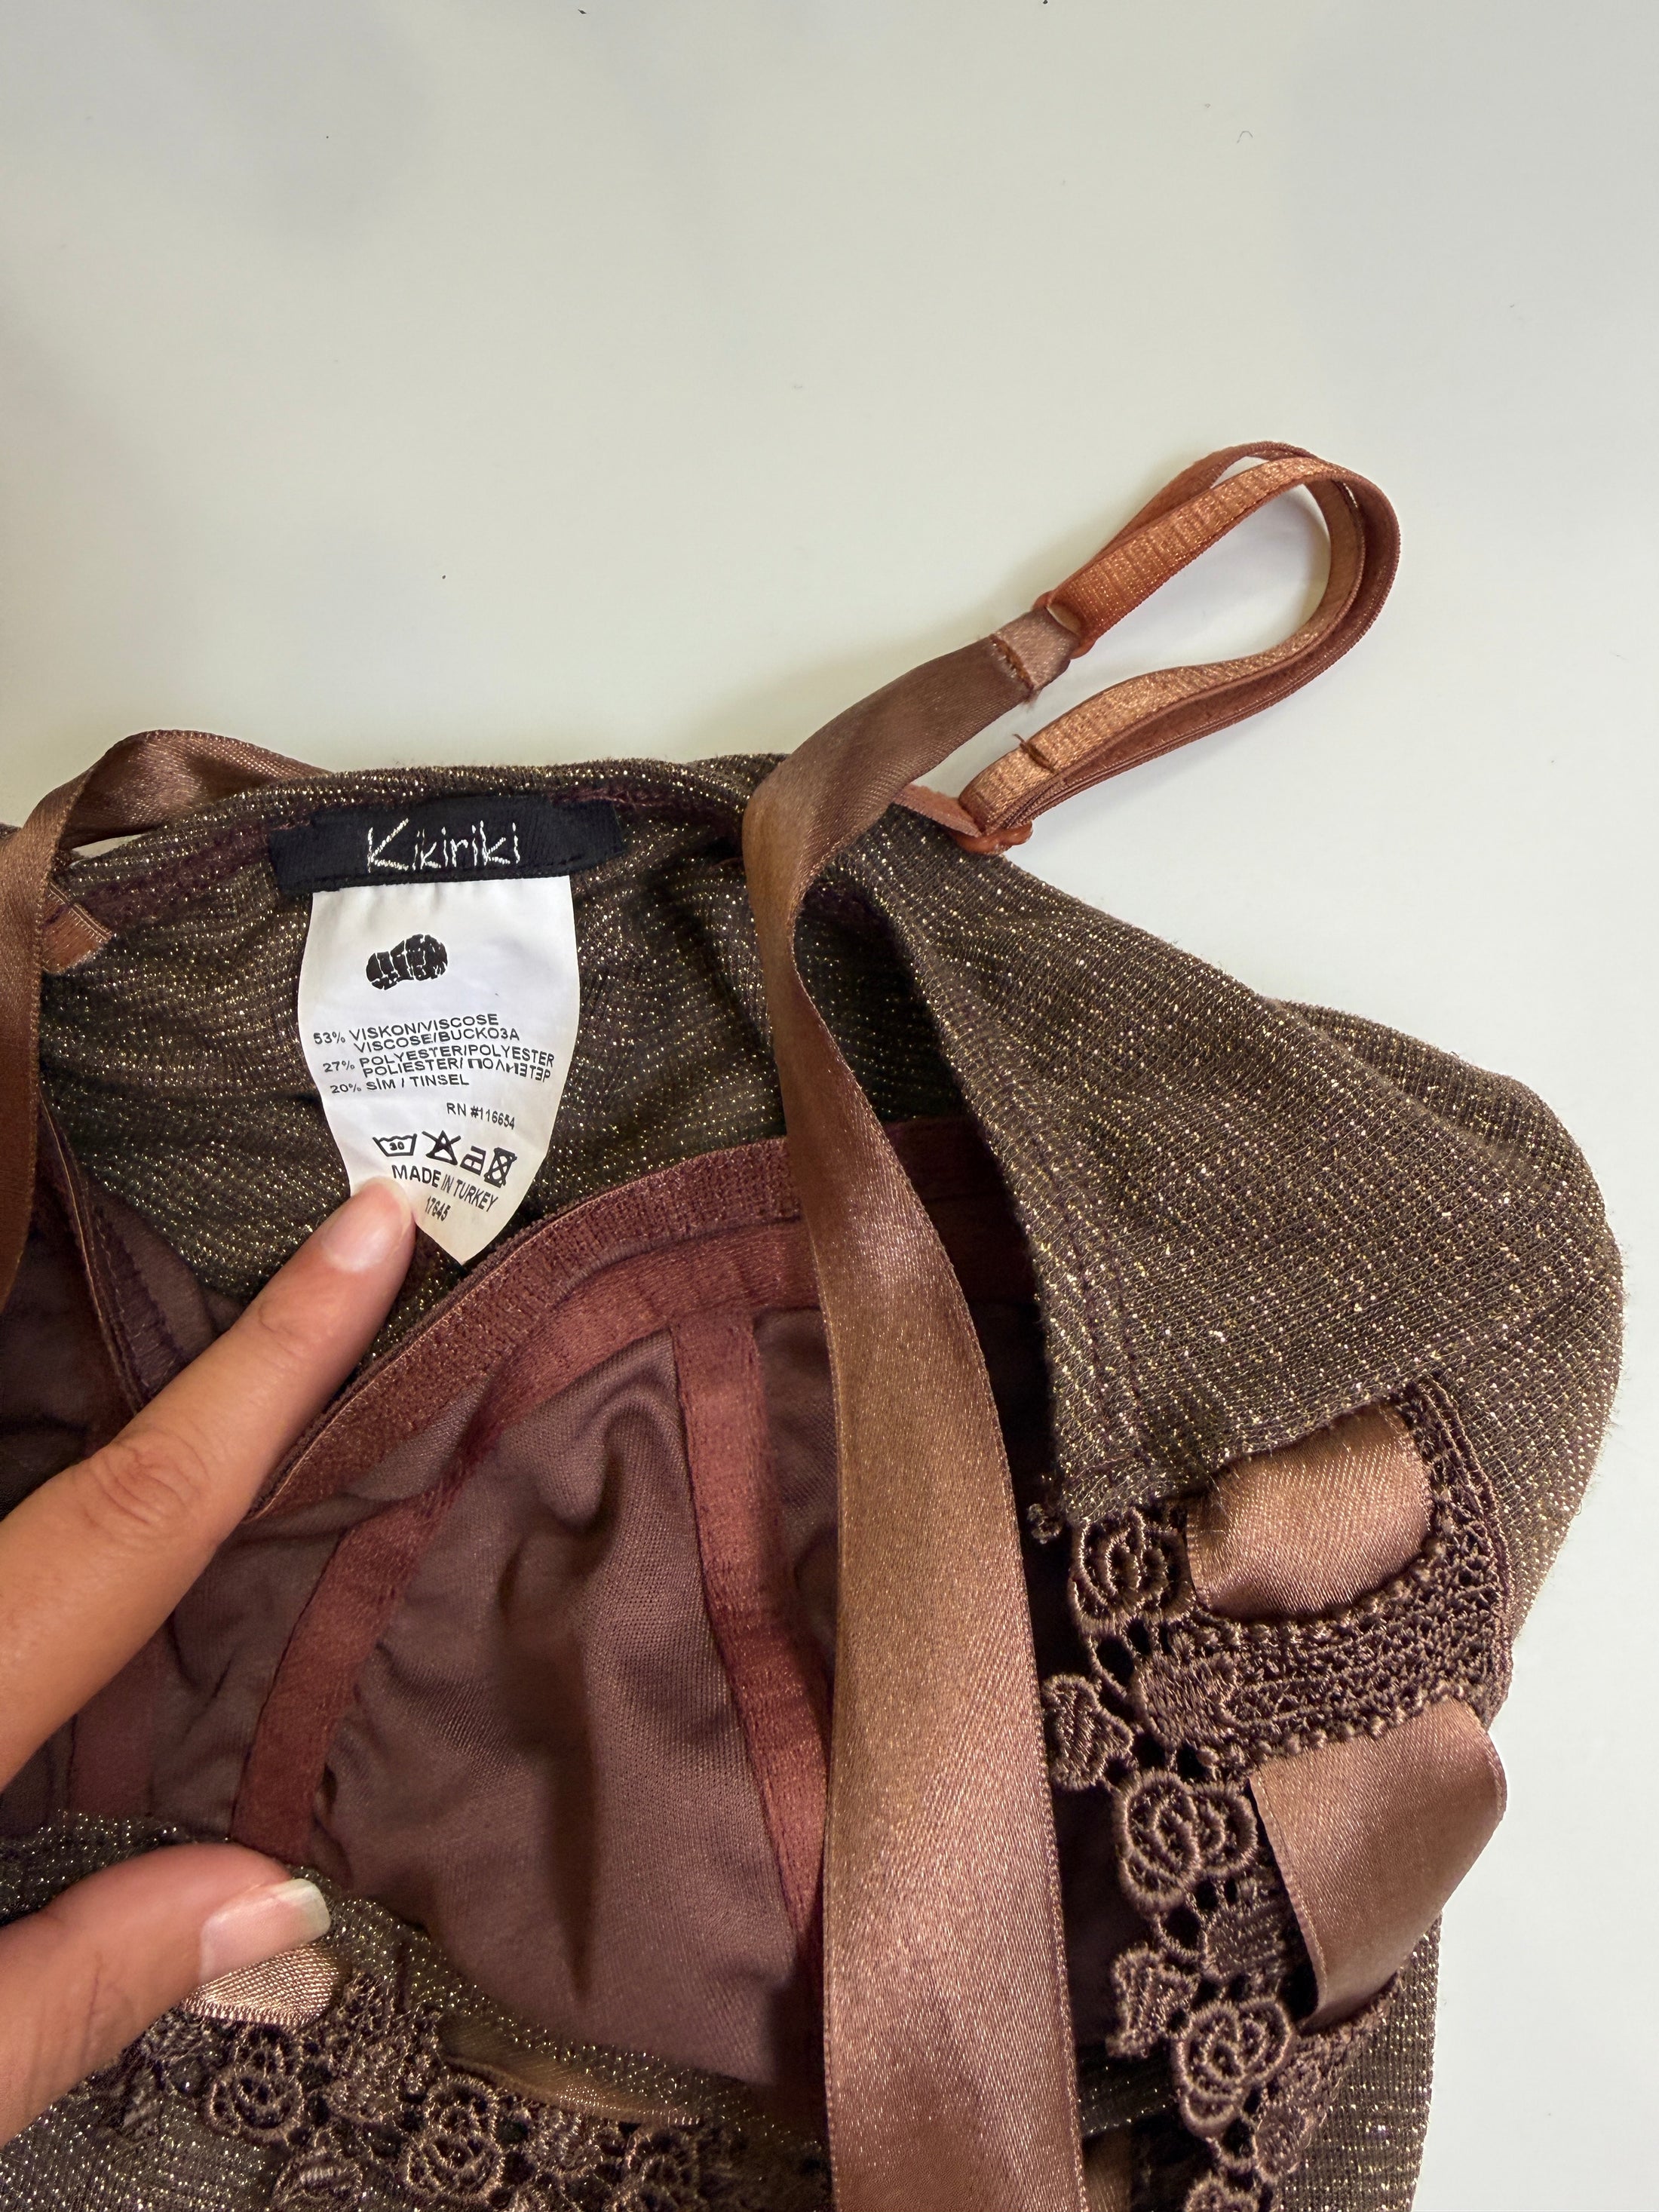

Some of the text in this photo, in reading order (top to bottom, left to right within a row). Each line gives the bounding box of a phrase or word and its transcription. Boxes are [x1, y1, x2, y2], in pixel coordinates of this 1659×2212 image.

[367, 817, 521, 873] Kikiriki
[313, 1031, 345, 1045] 53%
[323, 1060, 355, 1072] 27%
[330, 1083, 362, 1094] 20%
[409, 1073, 470, 1088] TINSEL
[446, 1102, 516, 1130] RN #116654
[391, 1164, 498, 1213] MADE IN TURKEY
